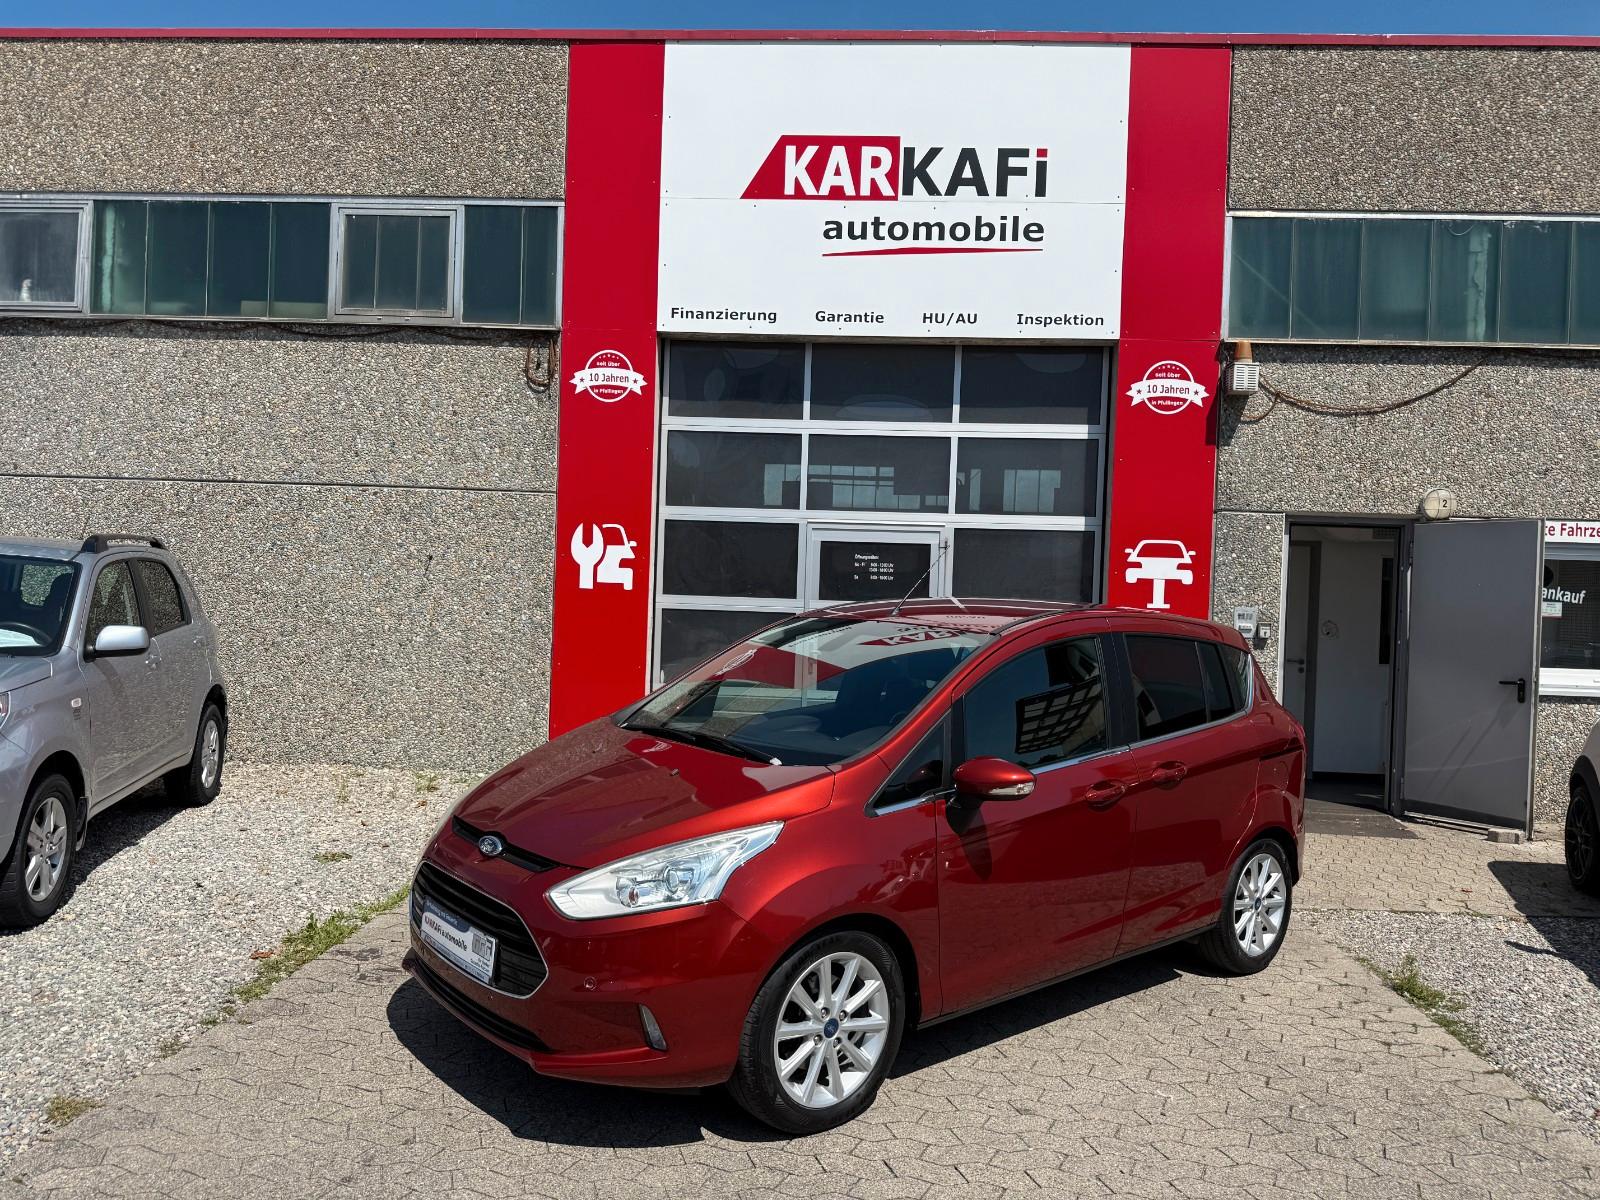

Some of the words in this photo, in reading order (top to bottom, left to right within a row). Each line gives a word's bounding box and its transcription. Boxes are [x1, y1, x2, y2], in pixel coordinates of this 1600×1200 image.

[822, 215, 1045, 242] automobile
[670, 307, 777, 324] Finanzierung
[815, 310, 885, 324] Garantie
[922, 312, 978, 325] HU/AU
[1017, 313, 1104, 327] Inspektion
[589, 373, 600, 382] 10
[601, 373, 630, 383] Jahren
[1147, 385, 1157, 393] 10
[1160, 385, 1189, 394] Jahren
[1442, 499, 1448, 508] 2
